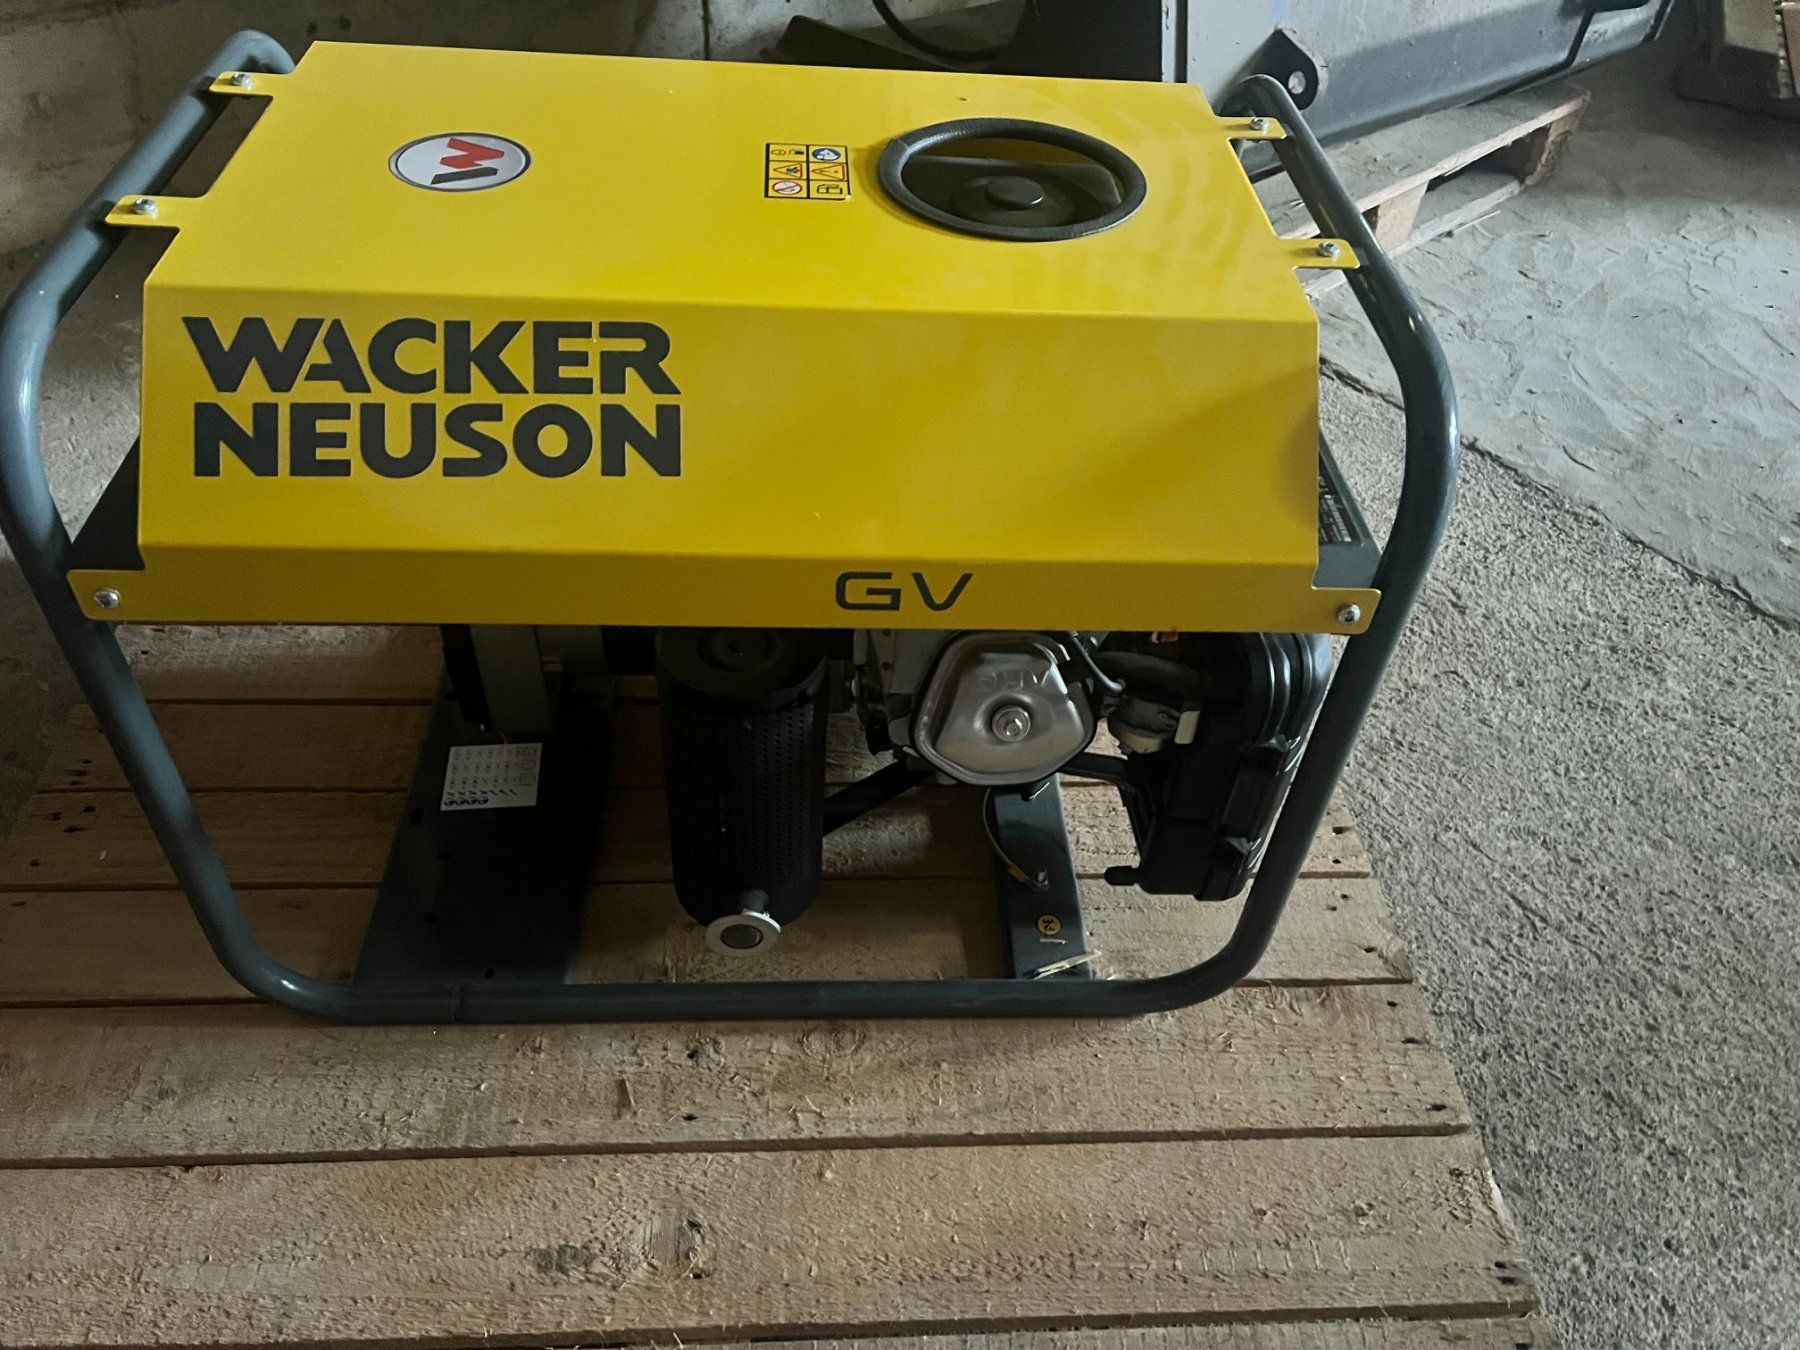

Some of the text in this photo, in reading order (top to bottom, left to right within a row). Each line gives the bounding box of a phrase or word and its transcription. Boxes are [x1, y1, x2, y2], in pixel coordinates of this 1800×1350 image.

[182, 316, 682, 395] WACKER
[194, 402, 682, 478] NEUSON
[835, 571, 974, 611] GV
